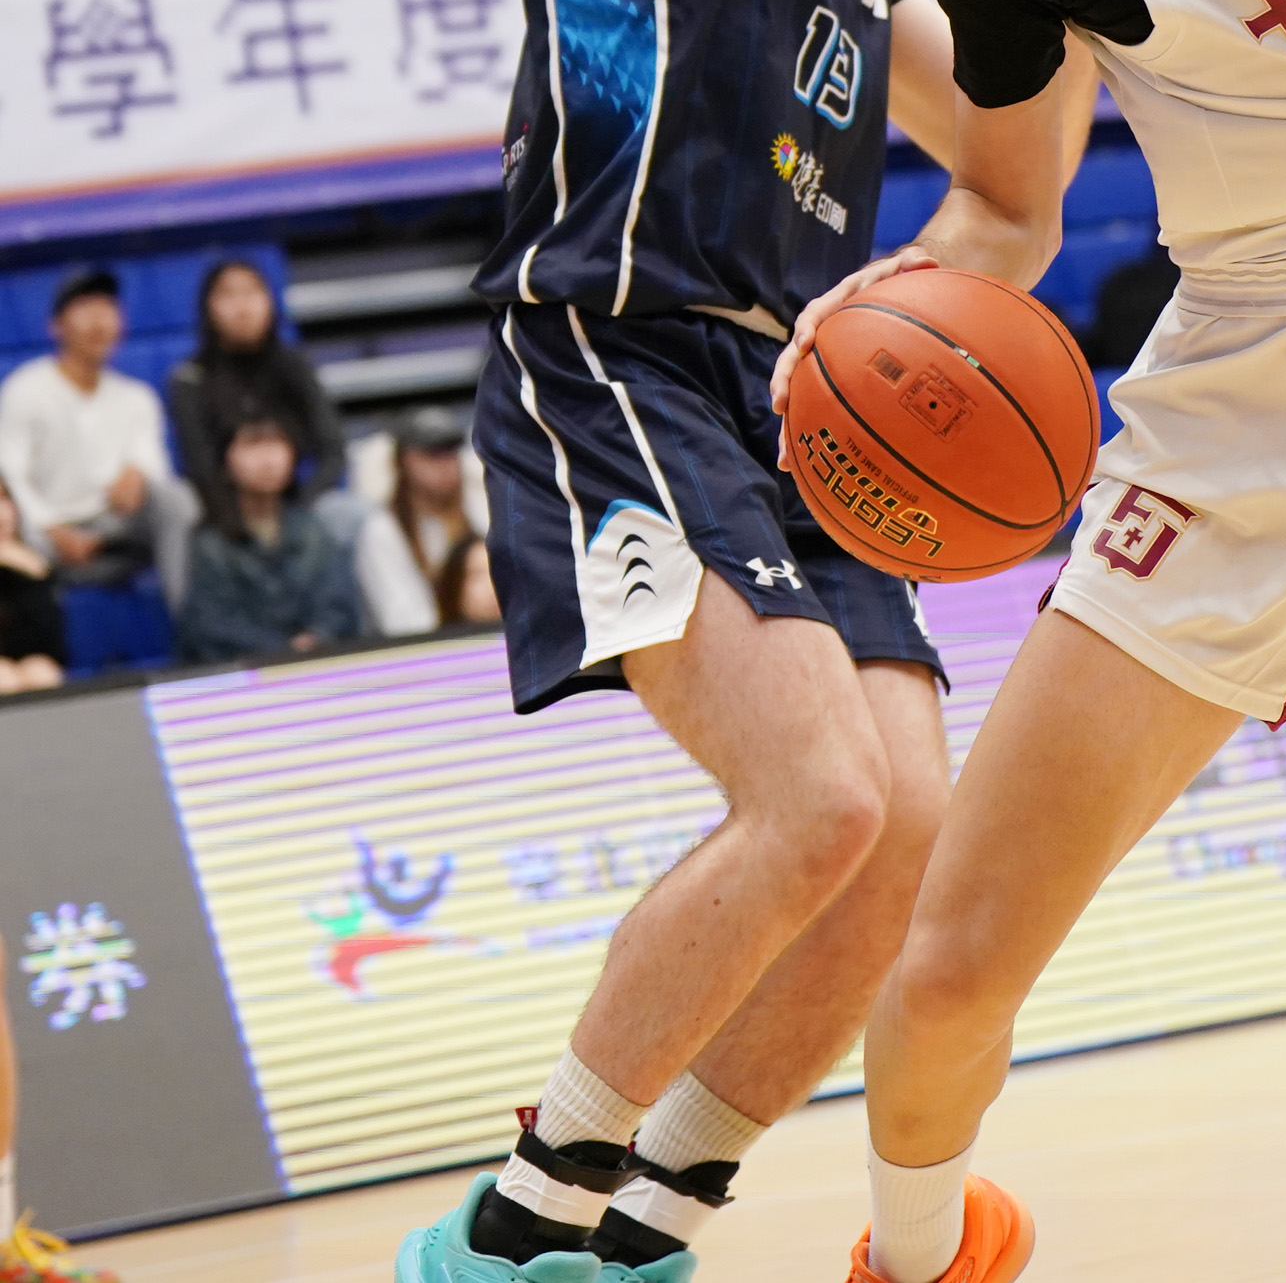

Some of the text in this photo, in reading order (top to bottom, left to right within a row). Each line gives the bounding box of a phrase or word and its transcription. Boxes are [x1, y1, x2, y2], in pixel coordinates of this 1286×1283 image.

[798, 431, 945, 558] LEGACY
[818, 427, 901, 512] 1000
[844, 436, 920, 505] OFFICIAL GAME BALL
